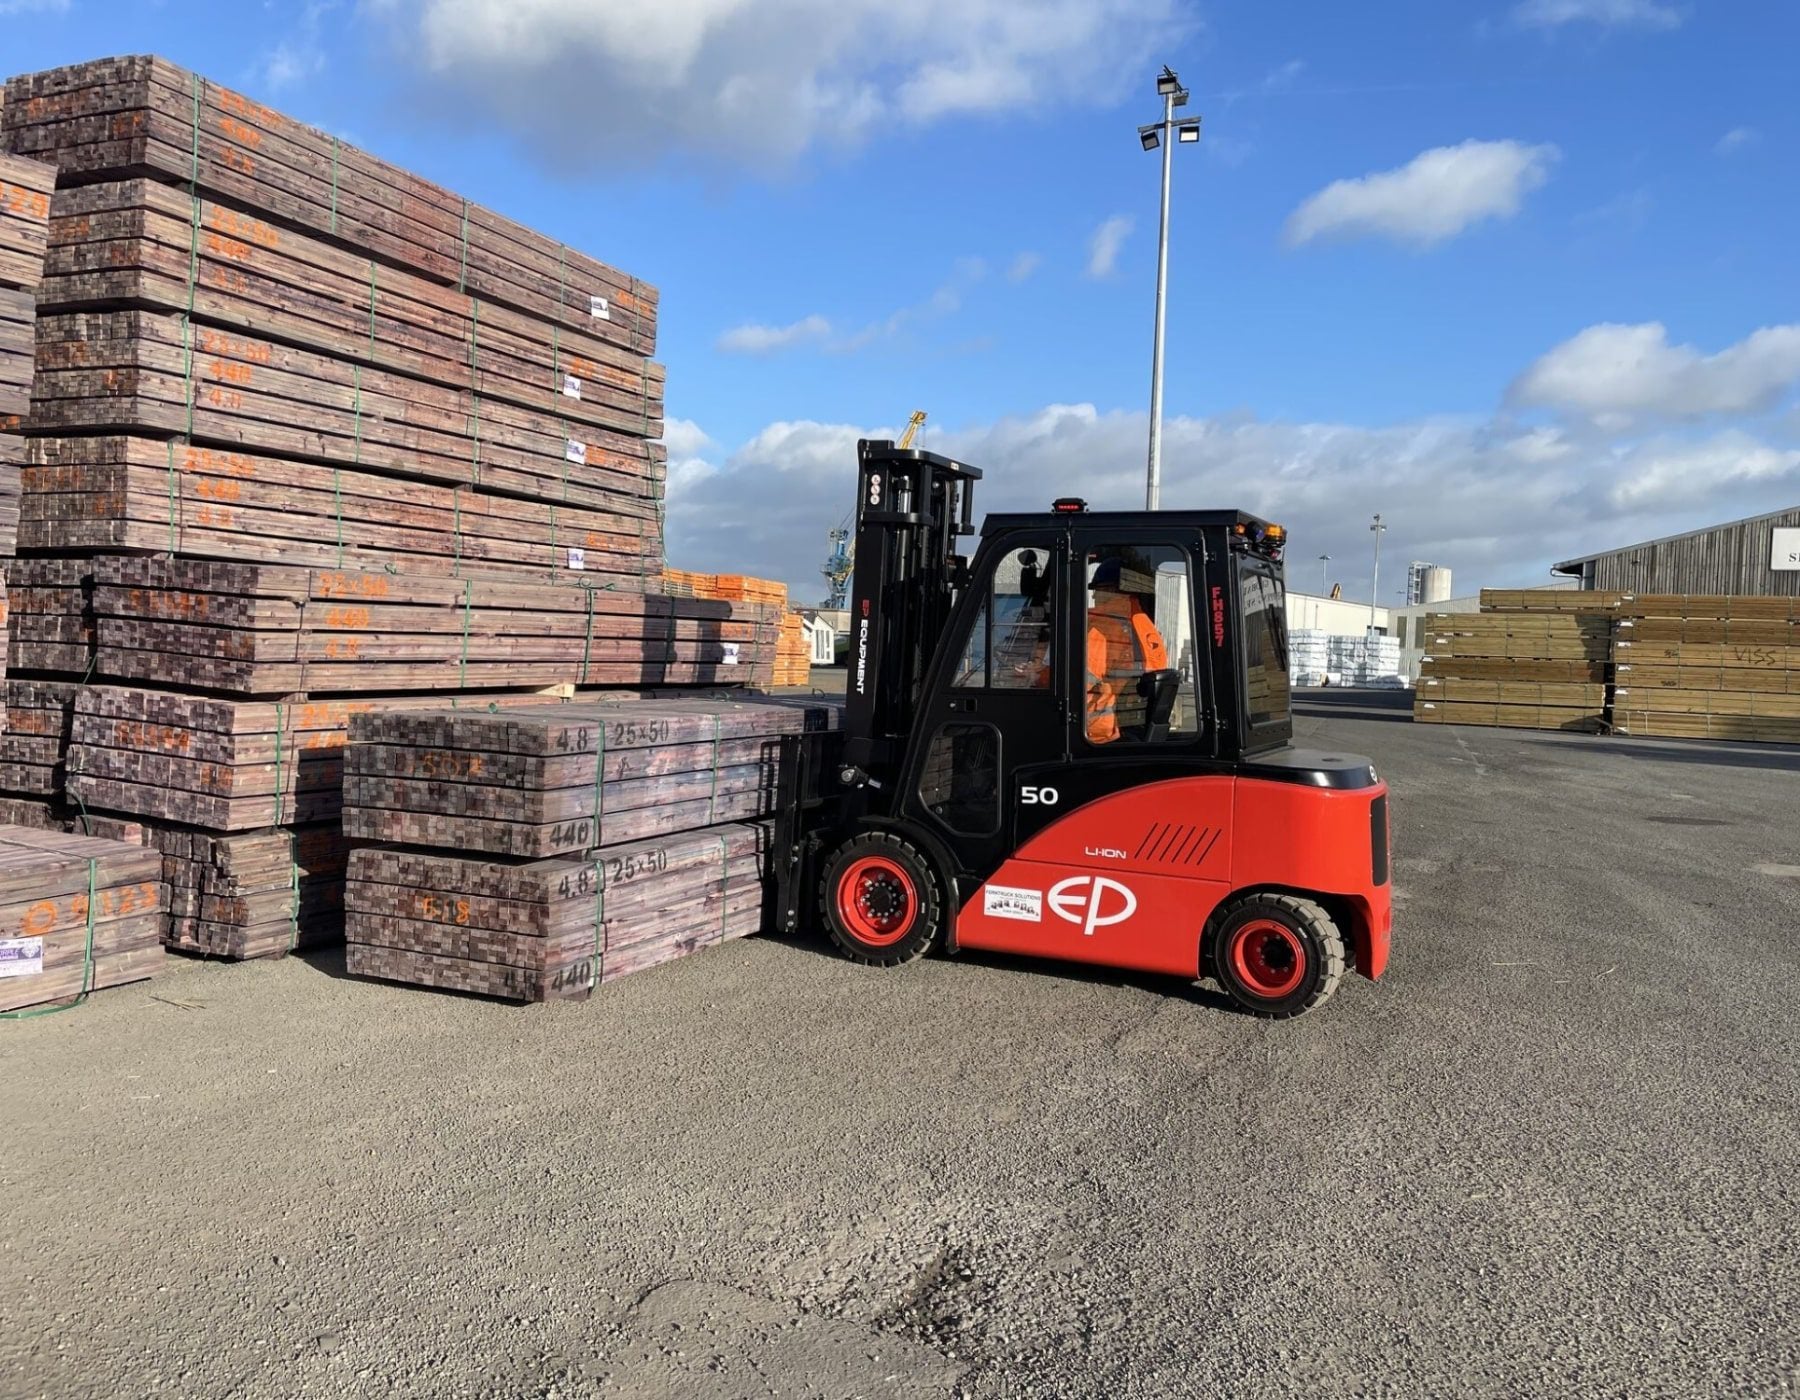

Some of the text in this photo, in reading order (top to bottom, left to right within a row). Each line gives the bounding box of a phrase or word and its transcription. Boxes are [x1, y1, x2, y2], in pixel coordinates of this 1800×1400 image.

[1212, 586, 1225, 648] FH857
[856, 619, 869, 695] EQUIPMENT
[1734, 647, 1776, 666] VISS
[556, 719, 669, 752] 4.8 25x50
[1021, 786, 1059, 805] 50
[549, 822, 589, 847] 440
[558, 848, 667, 899] 4.8 25x50
[1047, 875, 1138, 935] EP
[550, 962, 591, 992] 440
